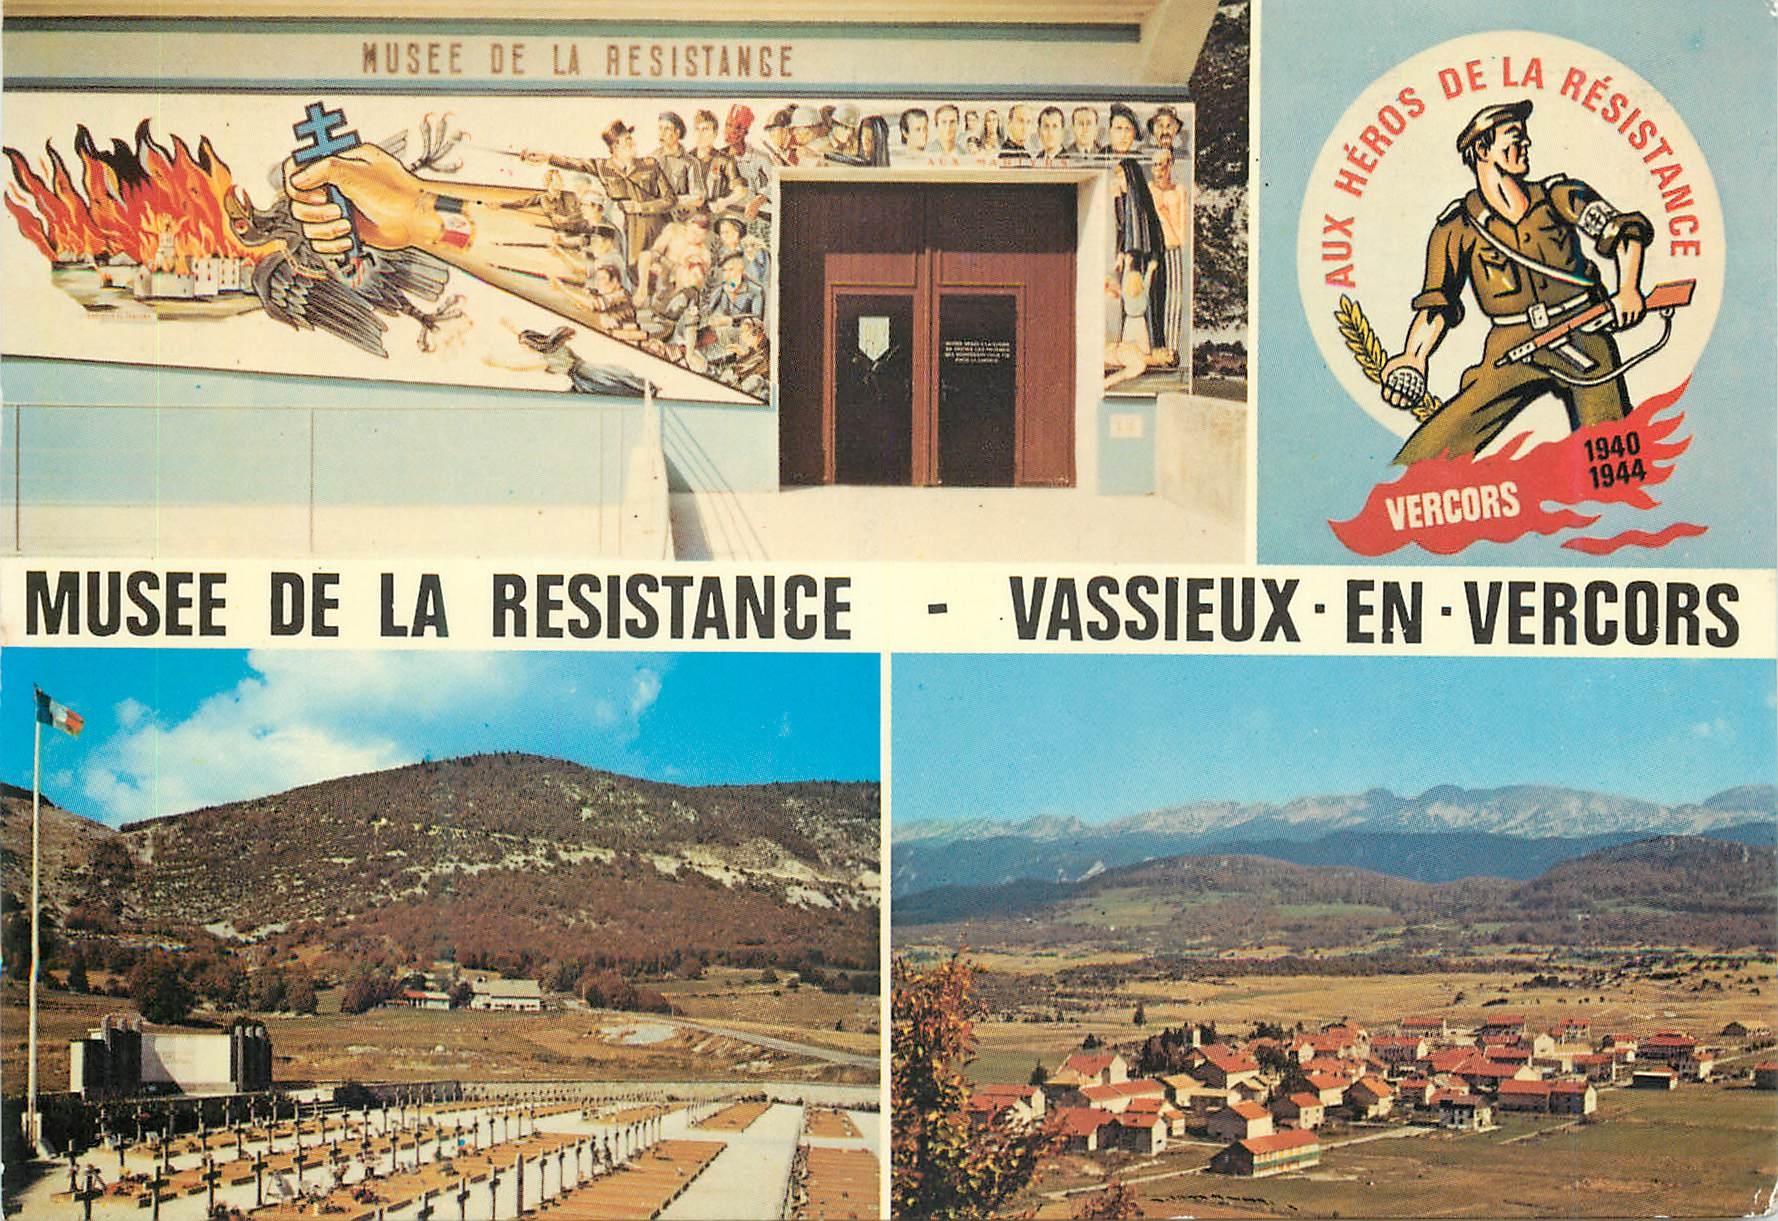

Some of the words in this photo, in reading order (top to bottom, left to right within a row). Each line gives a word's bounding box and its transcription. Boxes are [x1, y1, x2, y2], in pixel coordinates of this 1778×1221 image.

[362, 41, 463, 75] MUSEE
[490, 42, 526, 76] DE
[553, 43, 580, 76] LA
[1503, 57, 1543, 89] LA
[1438, 59, 1487, 100] DE
[1334, 87, 1426, 198] HÉROS
[1560, 66, 1701, 257] RÉSISTANCE
[1322, 214, 1356, 289] AUX
[1584, 431, 1640, 463] 1940
[1588, 458, 1647, 490] 1944
[1385, 481, 1521, 531] VERCORS
